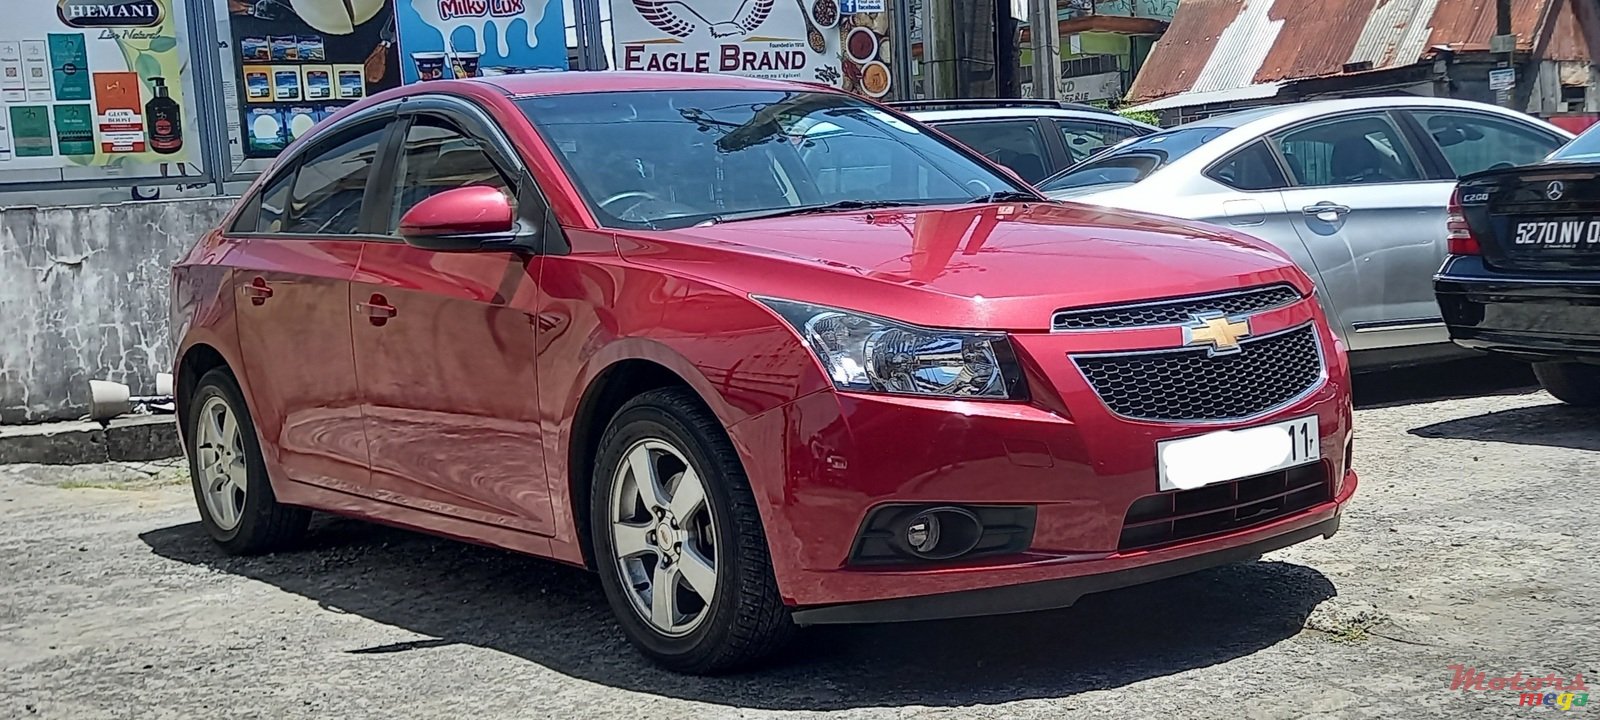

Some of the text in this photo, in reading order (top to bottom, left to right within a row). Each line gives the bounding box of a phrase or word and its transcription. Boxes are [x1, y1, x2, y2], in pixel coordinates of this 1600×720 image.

[69, 4, 154, 18] HEMANI
[440, 0, 524, 18] Milky Lux
[719, 44, 806, 72] BRAND
[1515, 221, 1600, 244] 5270 NV 0
[1288, 422, 1308, 462] 11
